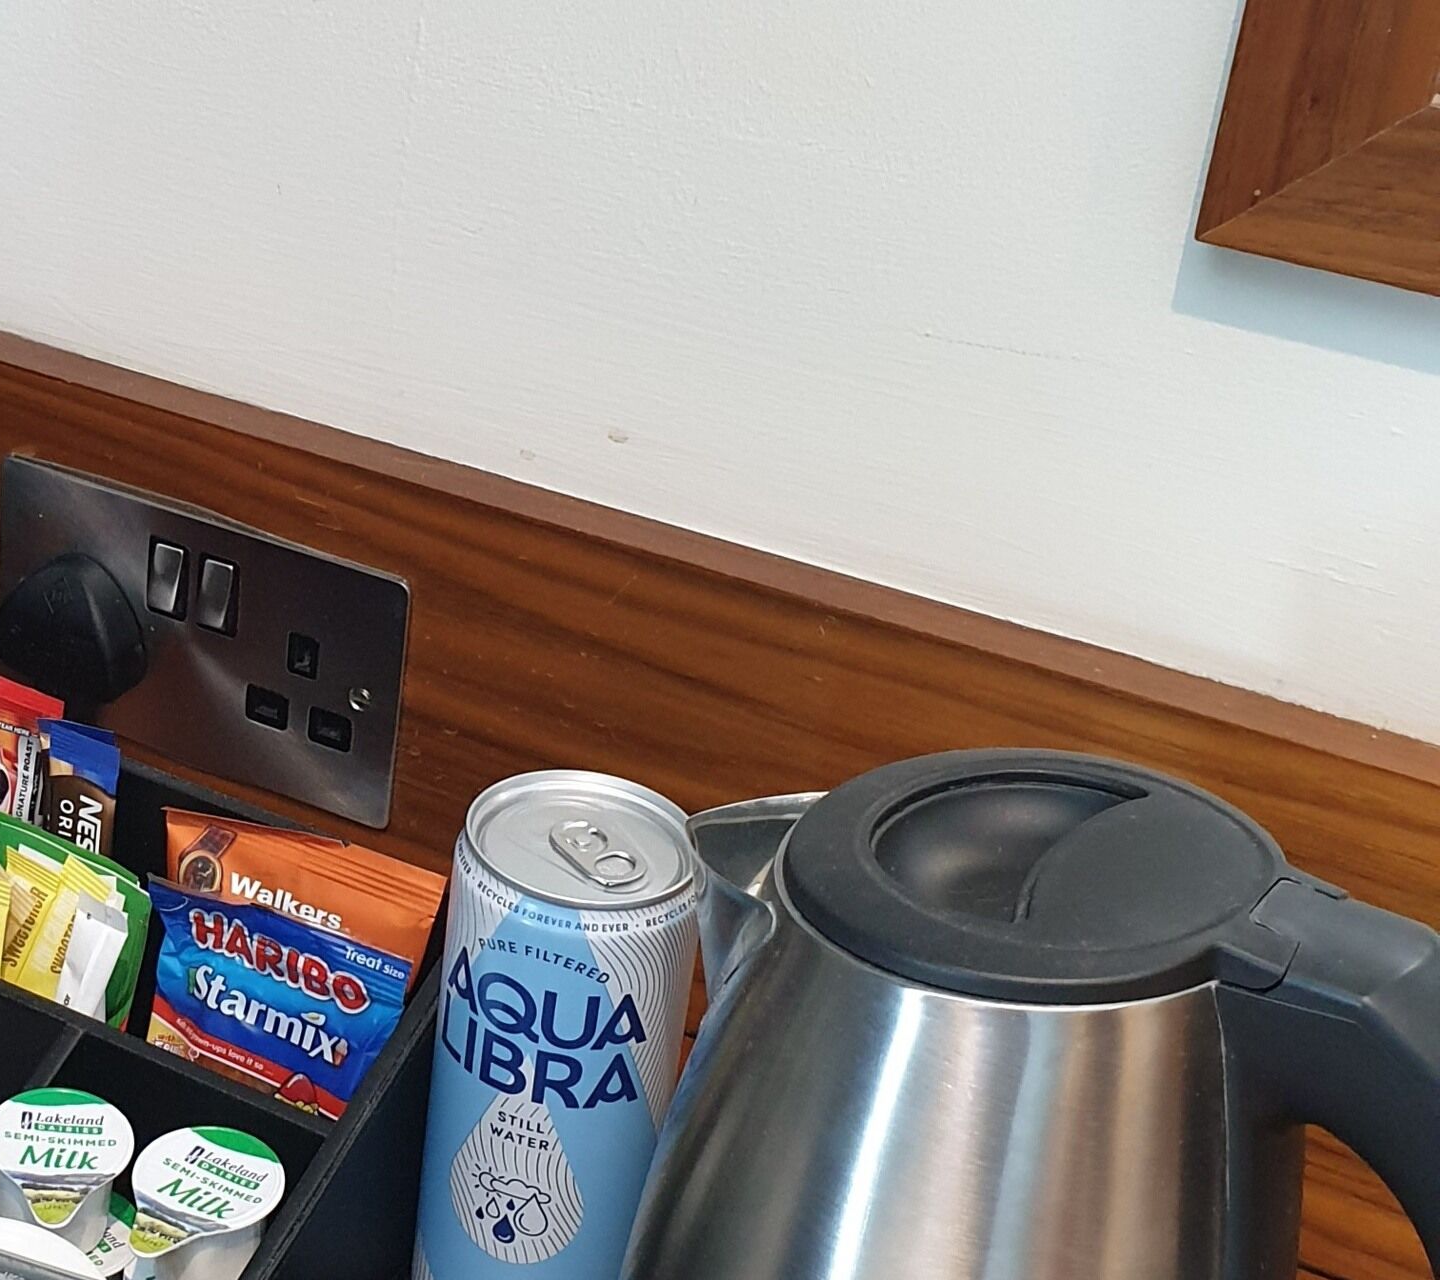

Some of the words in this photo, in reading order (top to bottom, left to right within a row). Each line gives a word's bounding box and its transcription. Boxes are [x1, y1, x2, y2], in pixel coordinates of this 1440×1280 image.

[16, 775, 30, 819] GNATURE
[23, 739, 35, 773] ROAST
[230, 872, 342, 930] Walkers
[477, 881, 520, 915] RECYCLES
[521, 903, 572, 930] FOREVER
[575, 921, 599, 933] AND
[601, 923, 629, 933] EVER
[645, 902, 688, 928] RECYCLES
[190, 910, 370, 1013] HARIBO
[343, 946, 383, 970] Treat
[478, 937, 518, 954] PURE
[524, 945, 611, 984] FILTERED
[192, 965, 336, 1064] Starmix
[448, 946, 647, 1051] AQUA
[442, 988, 638, 1109] LIBRA
[4, 1131, 117, 1147] SEMI-SKIMMED
[36, 1112, 105, 1126] Lakeland
[38, 1123, 100, 1134] DAIRIES
[489, 1122, 550, 1151] WATER
[497, 1111, 545, 1135] STILL
[19, 1145, 98, 1170] Milk
[203, 1151, 269, 1182] Lakeland
[157, 1178, 235, 1219] Milk
[162, 1157, 263, 1204] SEMI-SKIMMED
